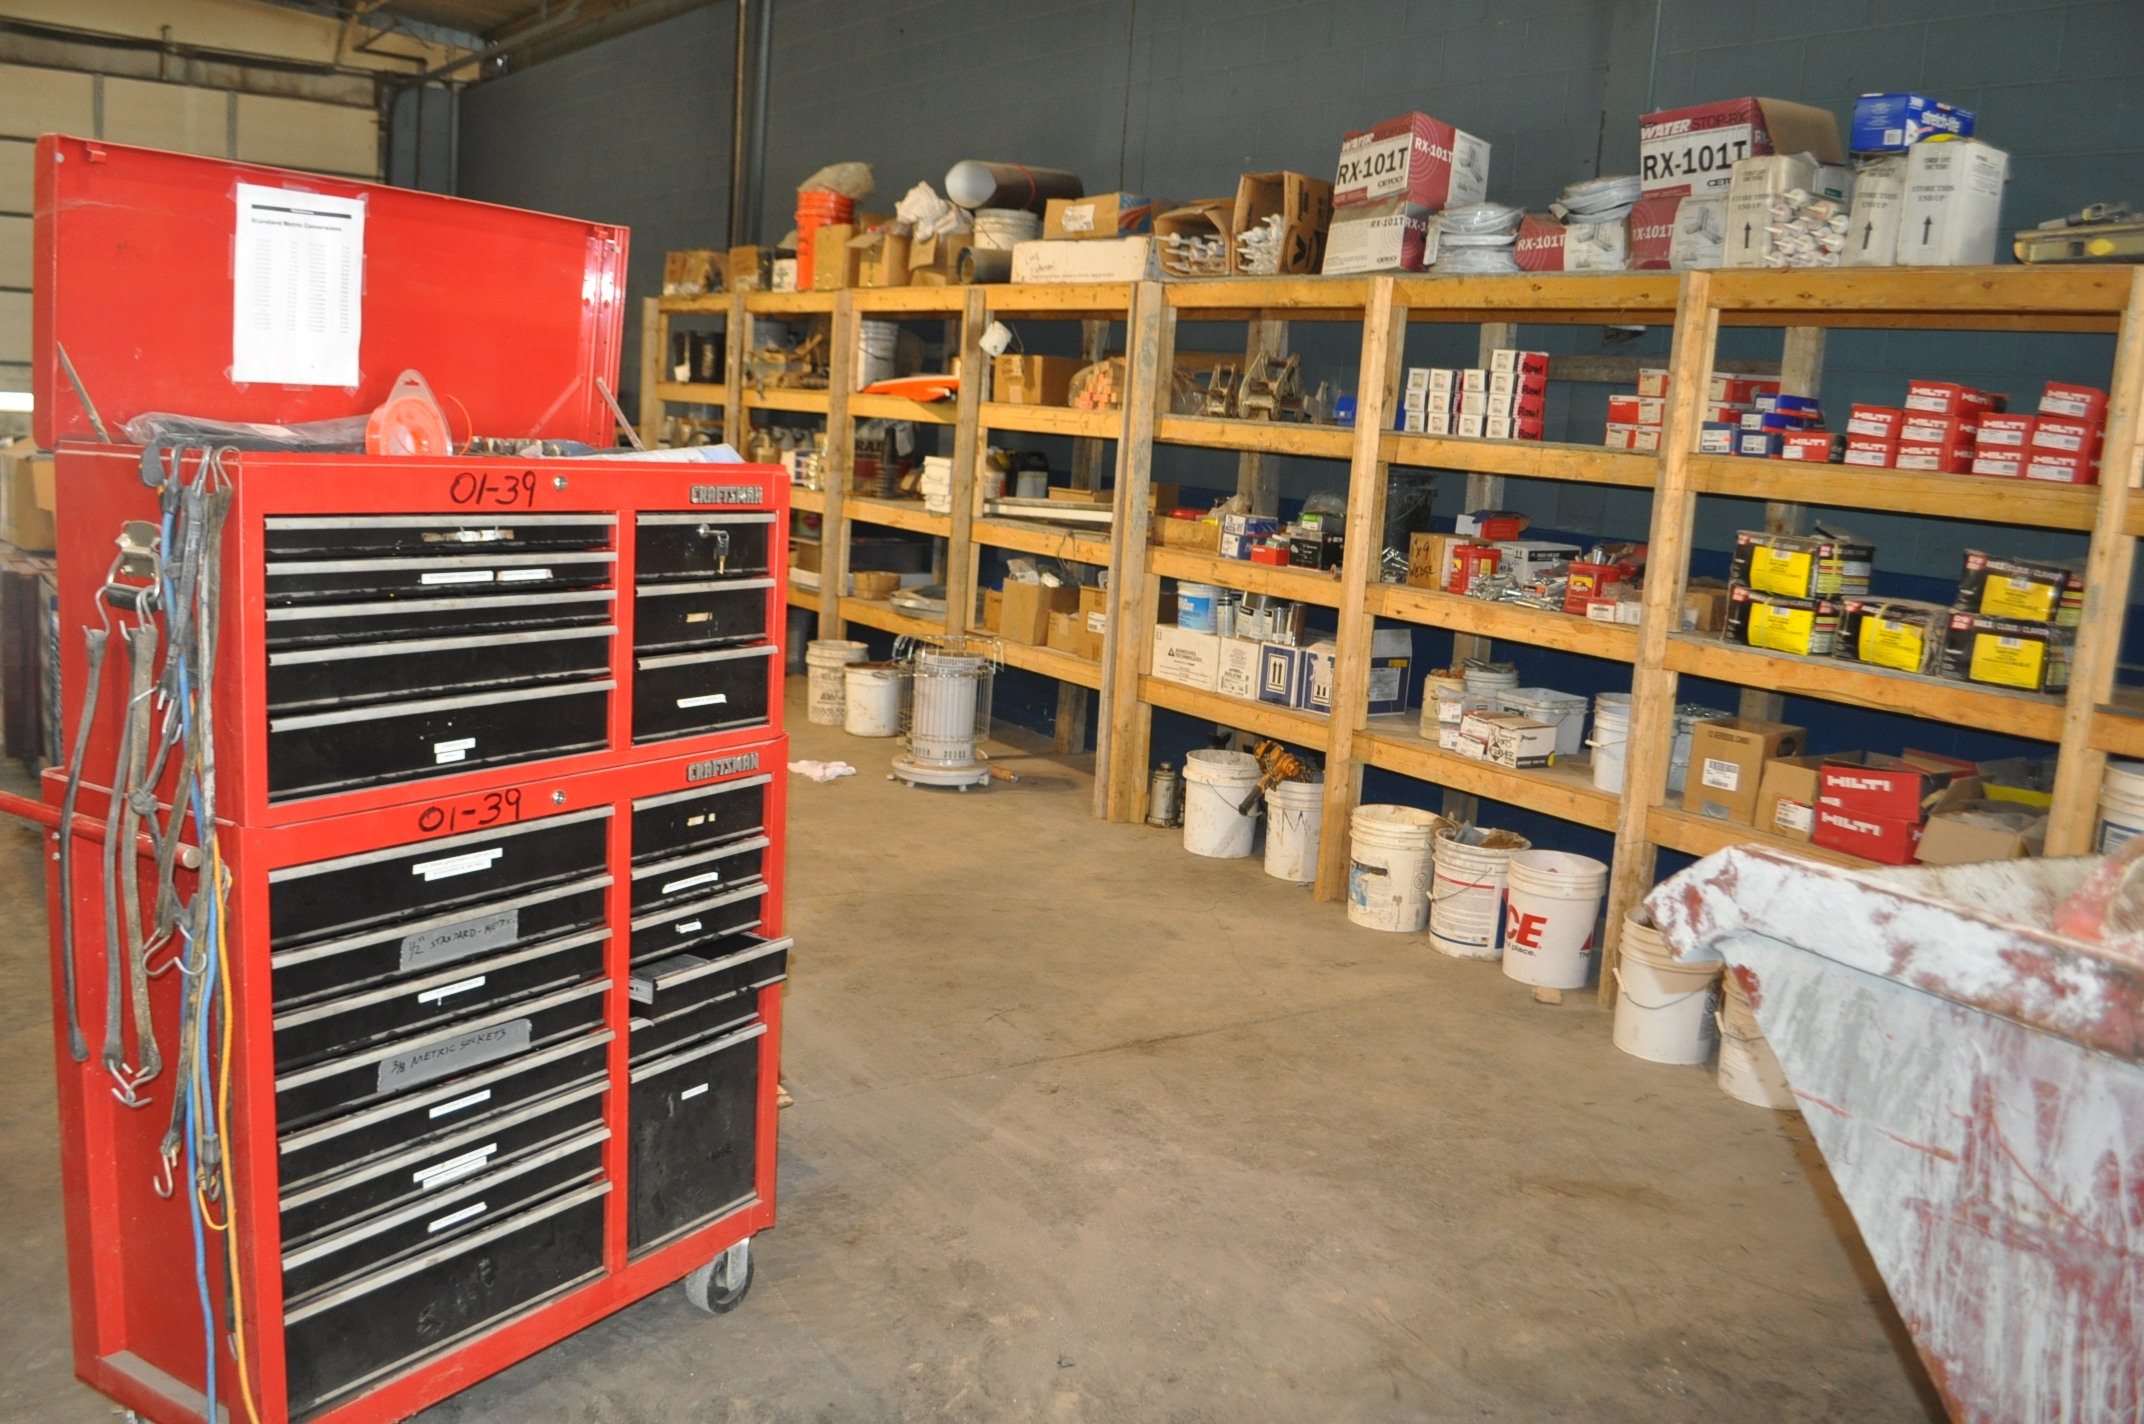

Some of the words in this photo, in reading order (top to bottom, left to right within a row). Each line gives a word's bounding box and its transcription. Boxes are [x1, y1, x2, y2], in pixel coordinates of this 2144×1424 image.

[1641, 119, 1692, 141] WATER
[1691, 113, 1749, 130] STOP-RX
[1414, 137, 1454, 164] RX-101T
[1337, 146, 1409, 186] RX-101T
[1642, 140, 1748, 182] RX-101T
[1369, 215, 1404, 229] RX-101T
[1632, 223, 1675, 242] RX-101T
[1516, 232, 1566, 252] RX-101T
[1910, 386, 1953, 398] HILTI
[2046, 389, 2093, 403] HILTI
[1853, 411, 1894, 423] HILTI
[1907, 417, 1949, 429] HILTI
[1982, 420, 2028, 430] HILTI
[2038, 423, 2085, 436] HILTI
[1789, 437, 1829, 447] HILTI
[1849, 441, 1889, 452] HILTI
[1899, 446, 1942, 456] HILTI
[1978, 450, 2023, 461] HILTI
[2031, 455, 2078, 467] HILTI
[449, 470, 537, 508] 01-39
[690, 486, 764, 504] CRAFTSMAN
[687, 752, 760, 782] CRAFTSMAN
[1826, 774, 1894, 792] HILTI
[418, 787, 522, 833] 01-39
[1820, 811, 1882, 837] HILTI
[1506, 904, 1548, 949] CE
[1511, 943, 1537, 957] place.
[410, 1044, 456, 1068] METRIC
[460, 1030, 507, 1049] SOCKETS
